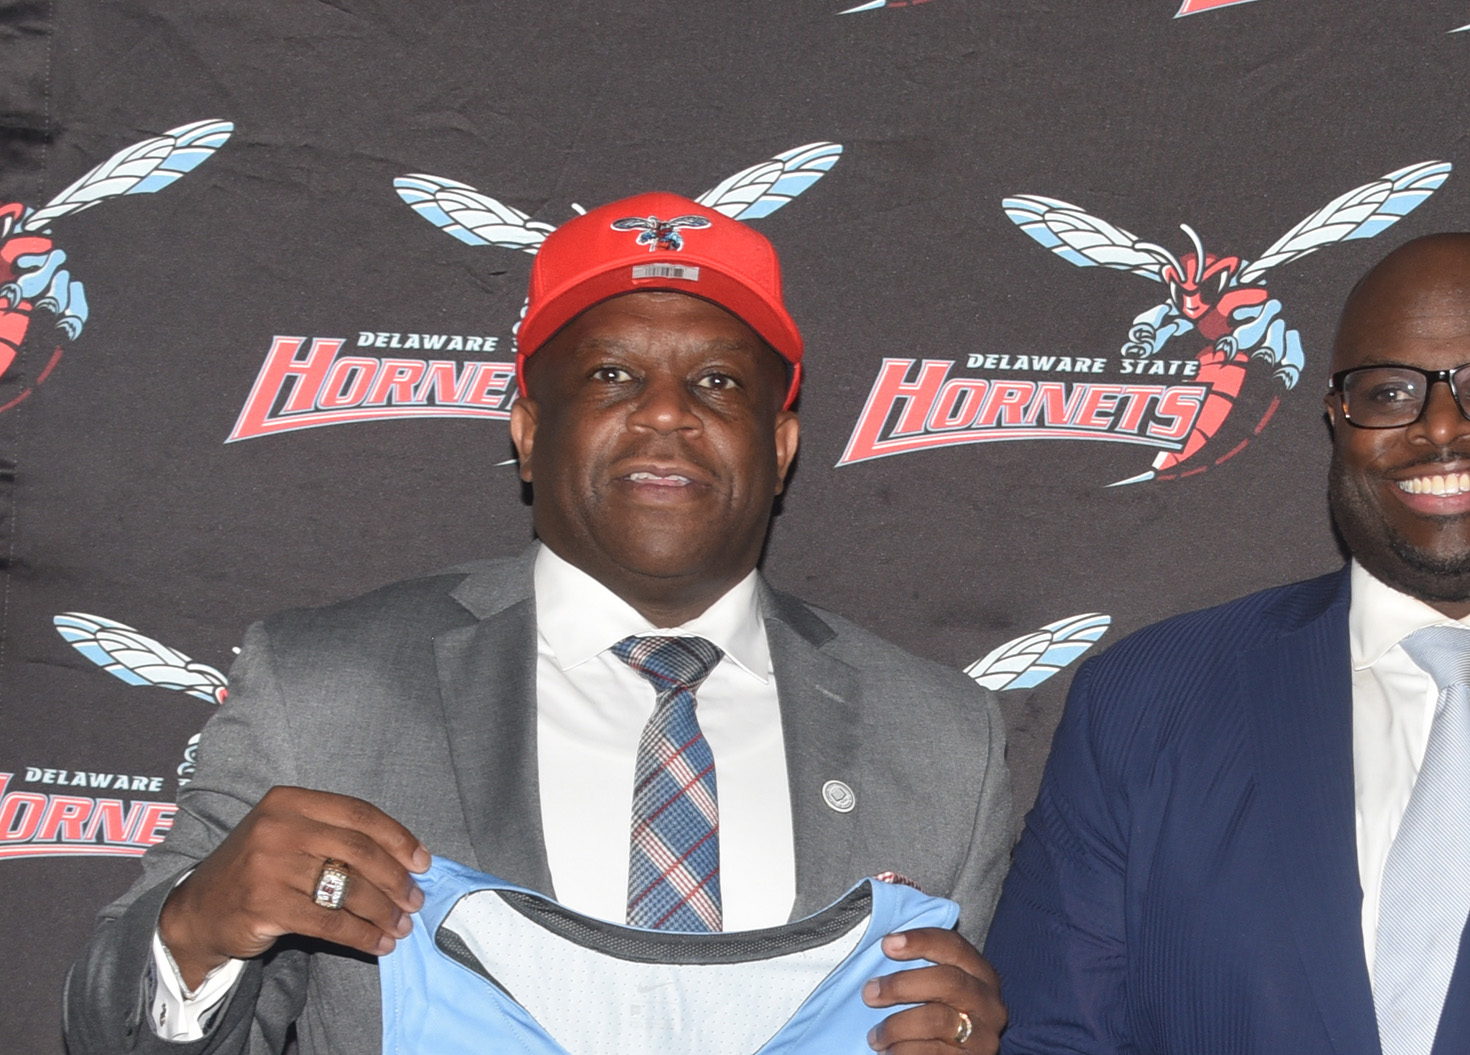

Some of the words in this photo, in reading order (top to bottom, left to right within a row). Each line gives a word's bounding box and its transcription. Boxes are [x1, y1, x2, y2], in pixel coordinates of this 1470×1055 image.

[357, 332, 498, 352] DELAWARE
[966, 353, 1107, 373] DELAWARE
[1120, 358, 1200, 376] STATE
[223, 335, 519, 444] HORNE
[835, 358, 1207, 468] HORNETS
[25, 766, 165, 792] DELAWARE
